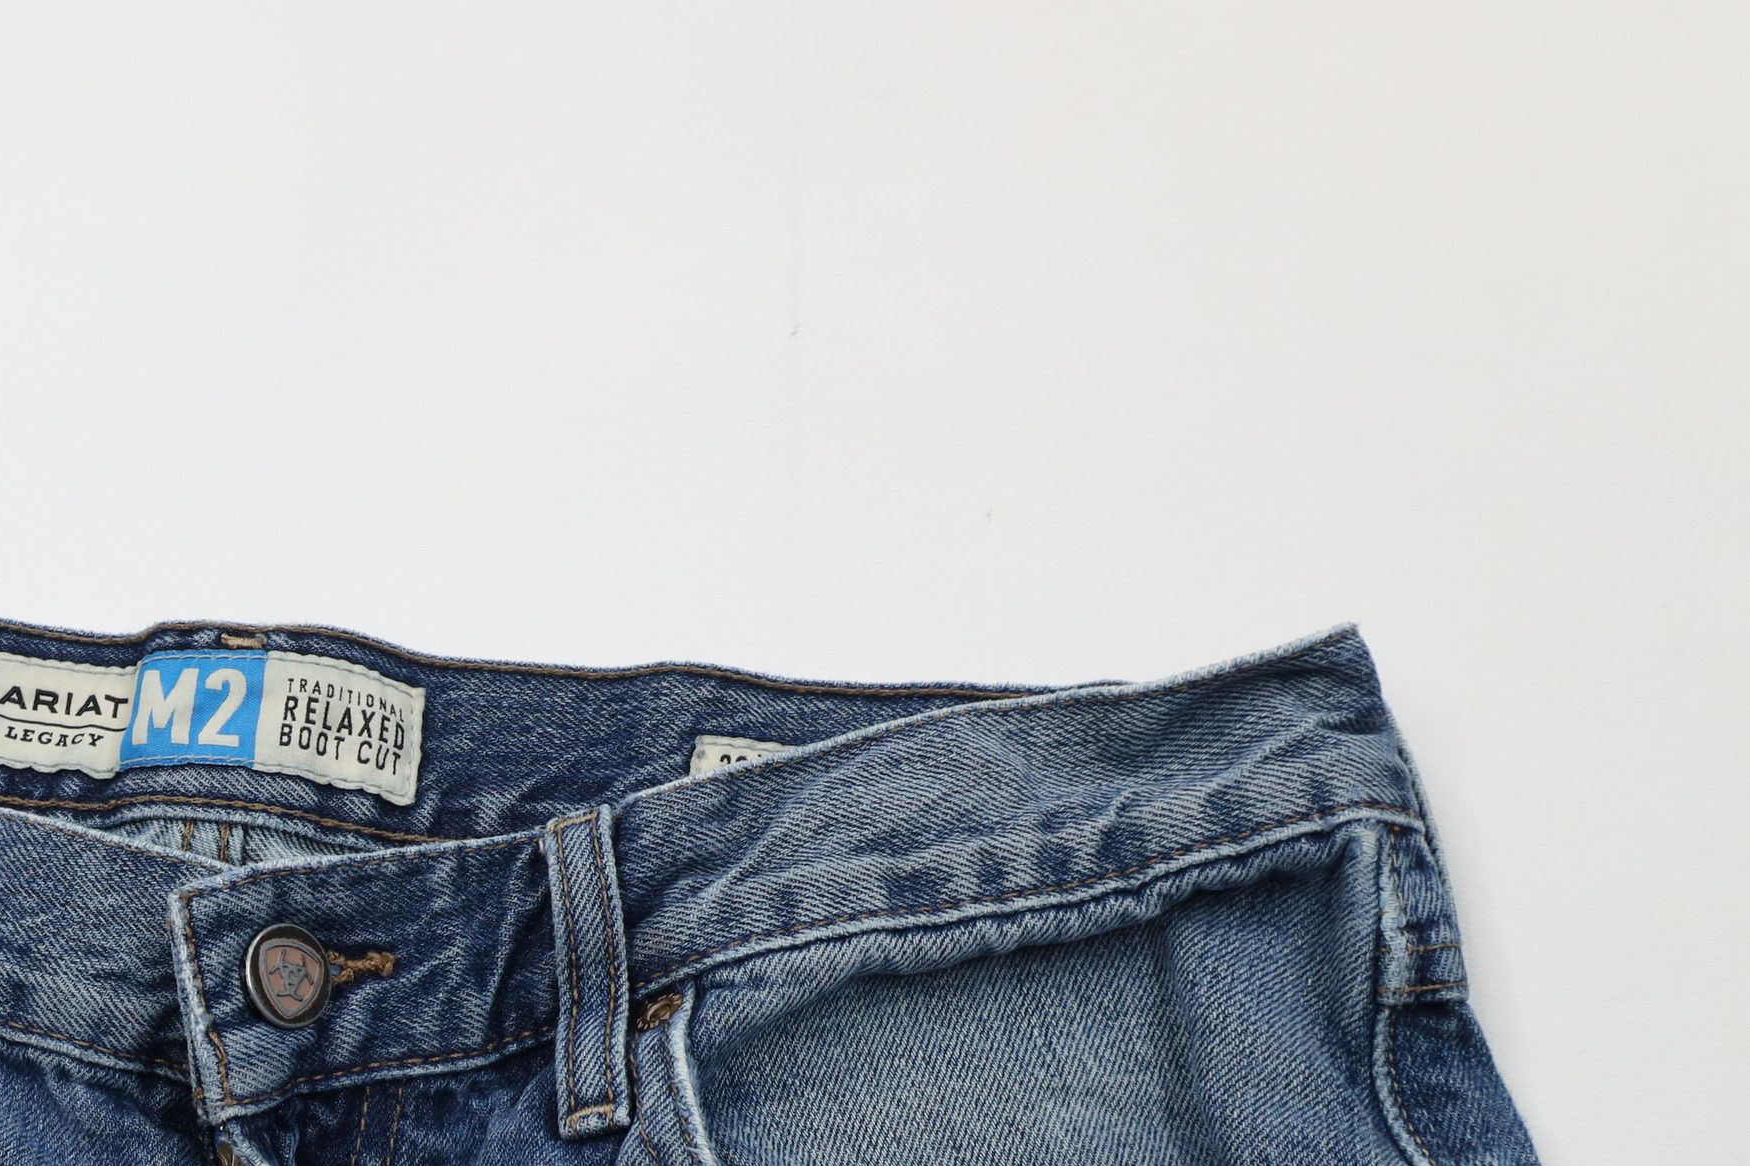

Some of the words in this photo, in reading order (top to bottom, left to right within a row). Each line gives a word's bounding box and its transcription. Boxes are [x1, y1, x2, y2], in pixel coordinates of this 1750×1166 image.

[131, 667, 247, 747] M2
[282, 695, 405, 751] RELAXED
[287, 678, 405, 723] TRADITIONAL
[4, 726, 104, 747] LEGACY
[279, 723, 345, 761] BOOT
[357, 740, 401, 775] CUT
